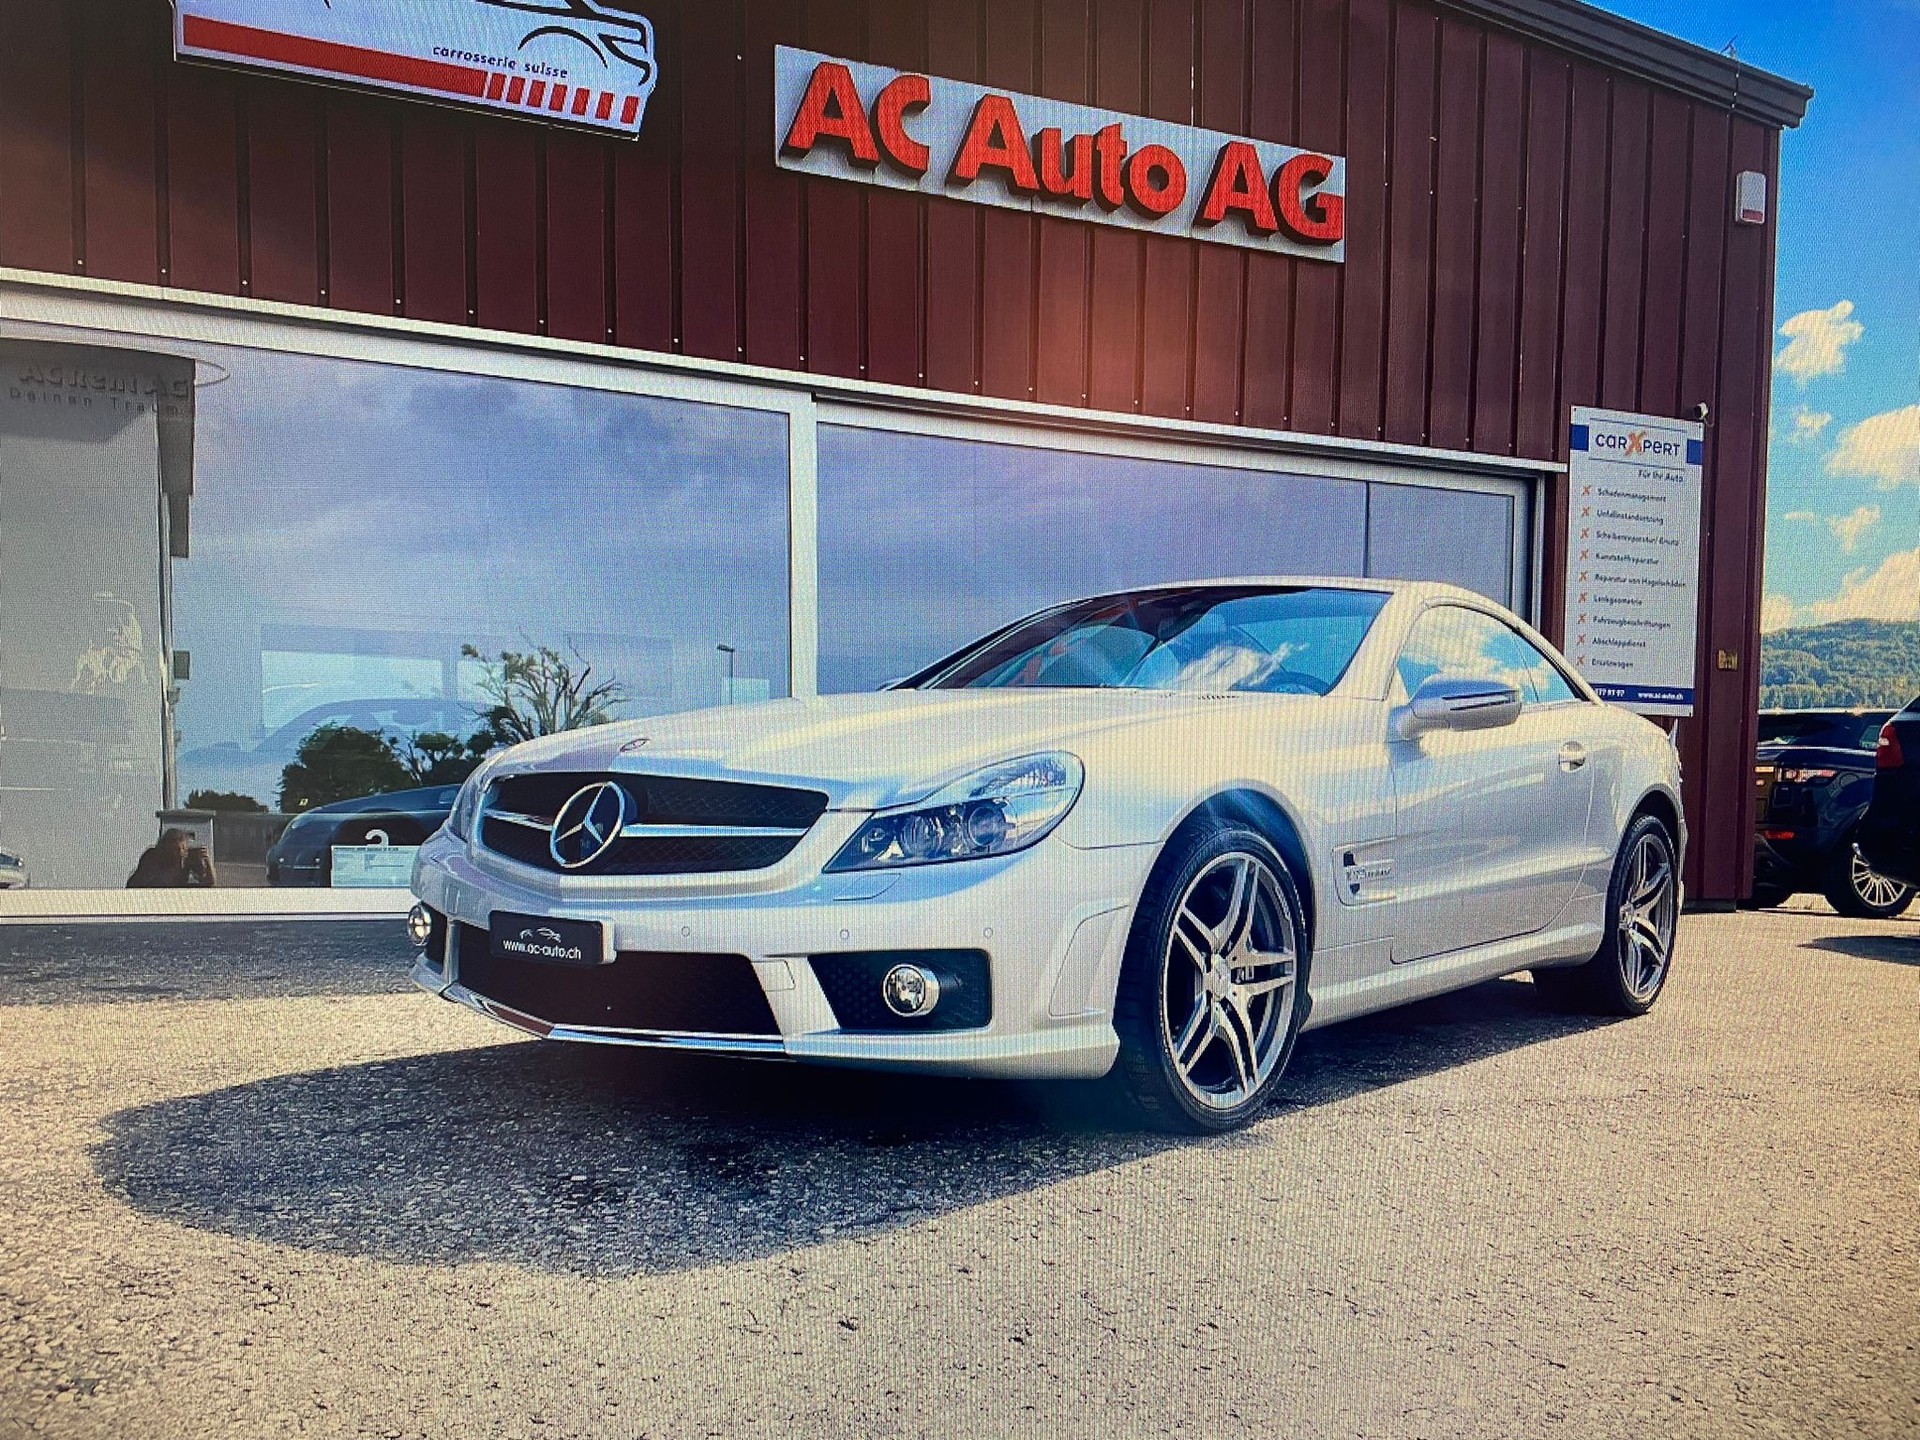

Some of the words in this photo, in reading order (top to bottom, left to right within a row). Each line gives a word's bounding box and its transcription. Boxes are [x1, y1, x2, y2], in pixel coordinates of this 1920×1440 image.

[433, 46, 516, 69] carrosserie
[524, 62, 568, 78] suisse
[781, 61, 931, 178] AC
[946, 94, 1187, 219] Auto
[1193, 140, 1344, 245] AG
[502, 939, 582, 960] www.ac-auto.ch
